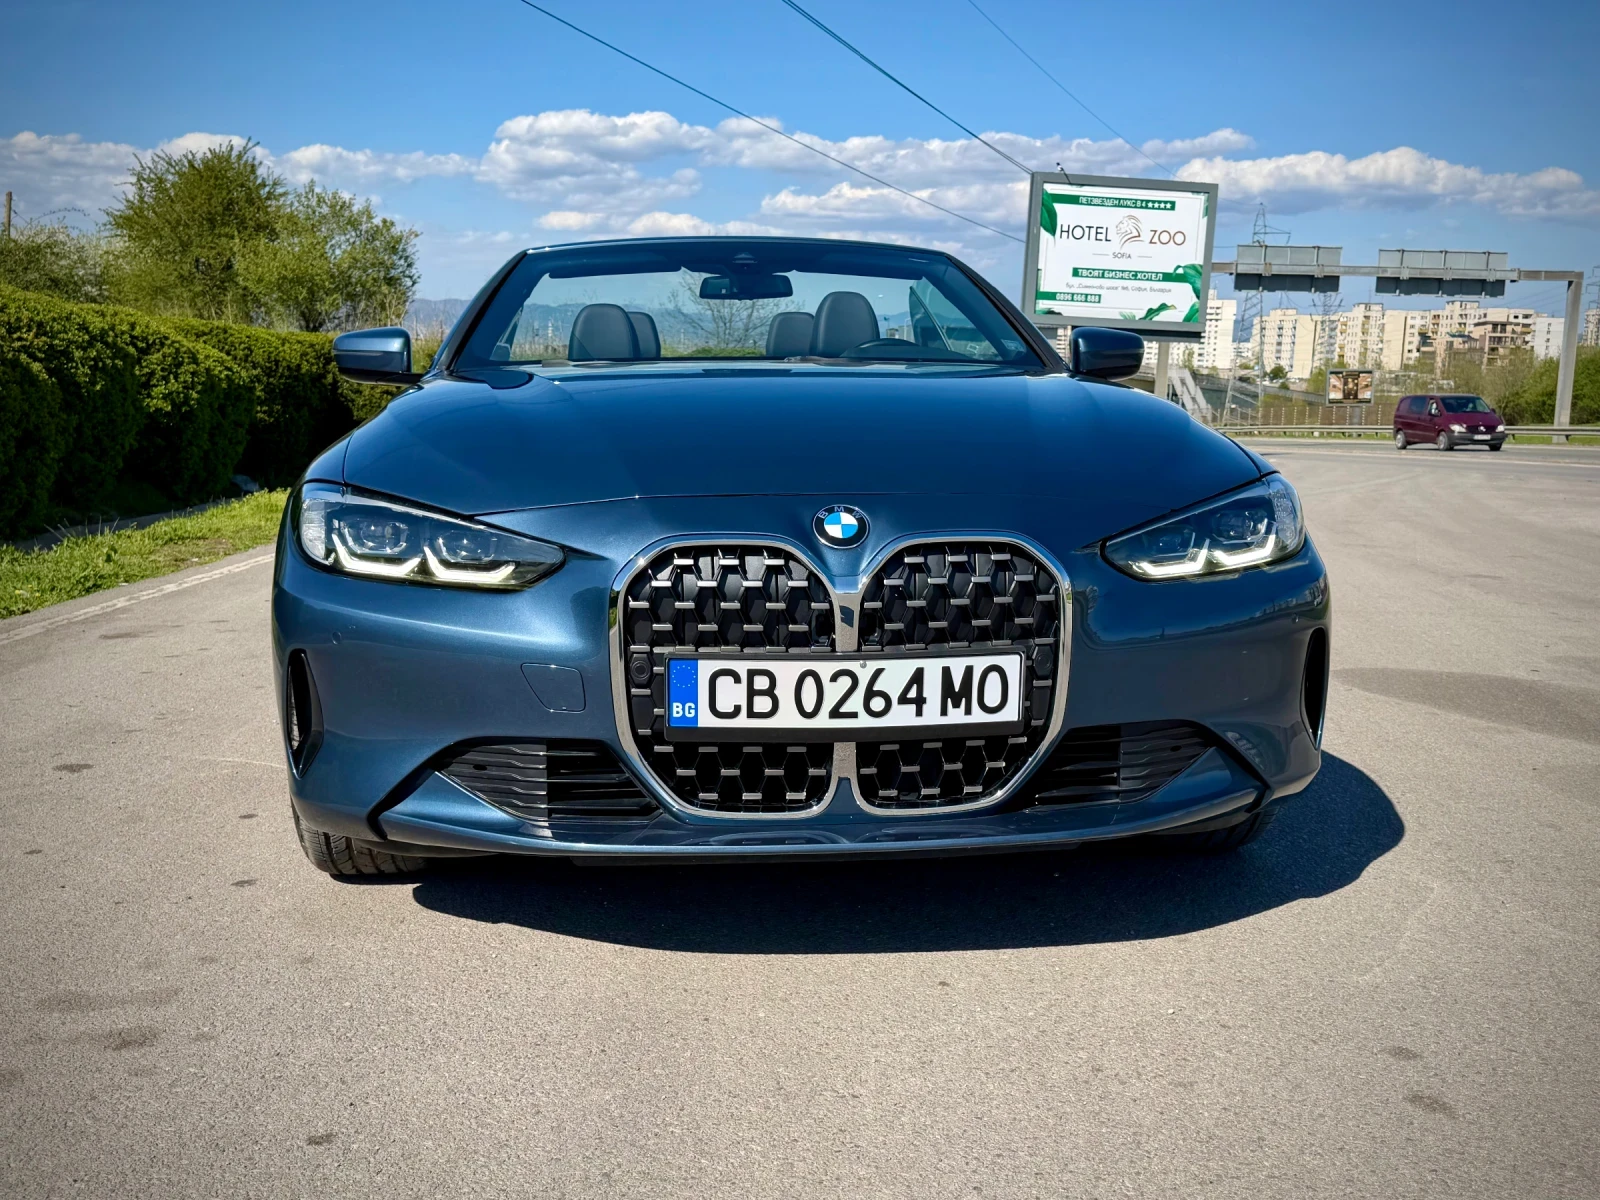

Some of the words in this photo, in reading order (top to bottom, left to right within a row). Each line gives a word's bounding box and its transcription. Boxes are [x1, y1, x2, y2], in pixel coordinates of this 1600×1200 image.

[1119, 199, 1136, 207] ЛУКС
[1059, 224, 1112, 242] HOTEL
[1149, 229, 1186, 246] ZOO
[1112, 252, 1132, 260] SOFIA
[1077, 269, 1103, 278] ТВОЯТ
[1104, 270, 1135, 280] БИЗНЕС
[1136, 272, 1163, 281] ХОТЕЛ
[817, 506, 862, 519] BMW
[708, 667, 779, 719] CB
[794, 667, 927, 720] 0264
[940, 664, 1009, 716] MO
[672, 703, 695, 718] BG
